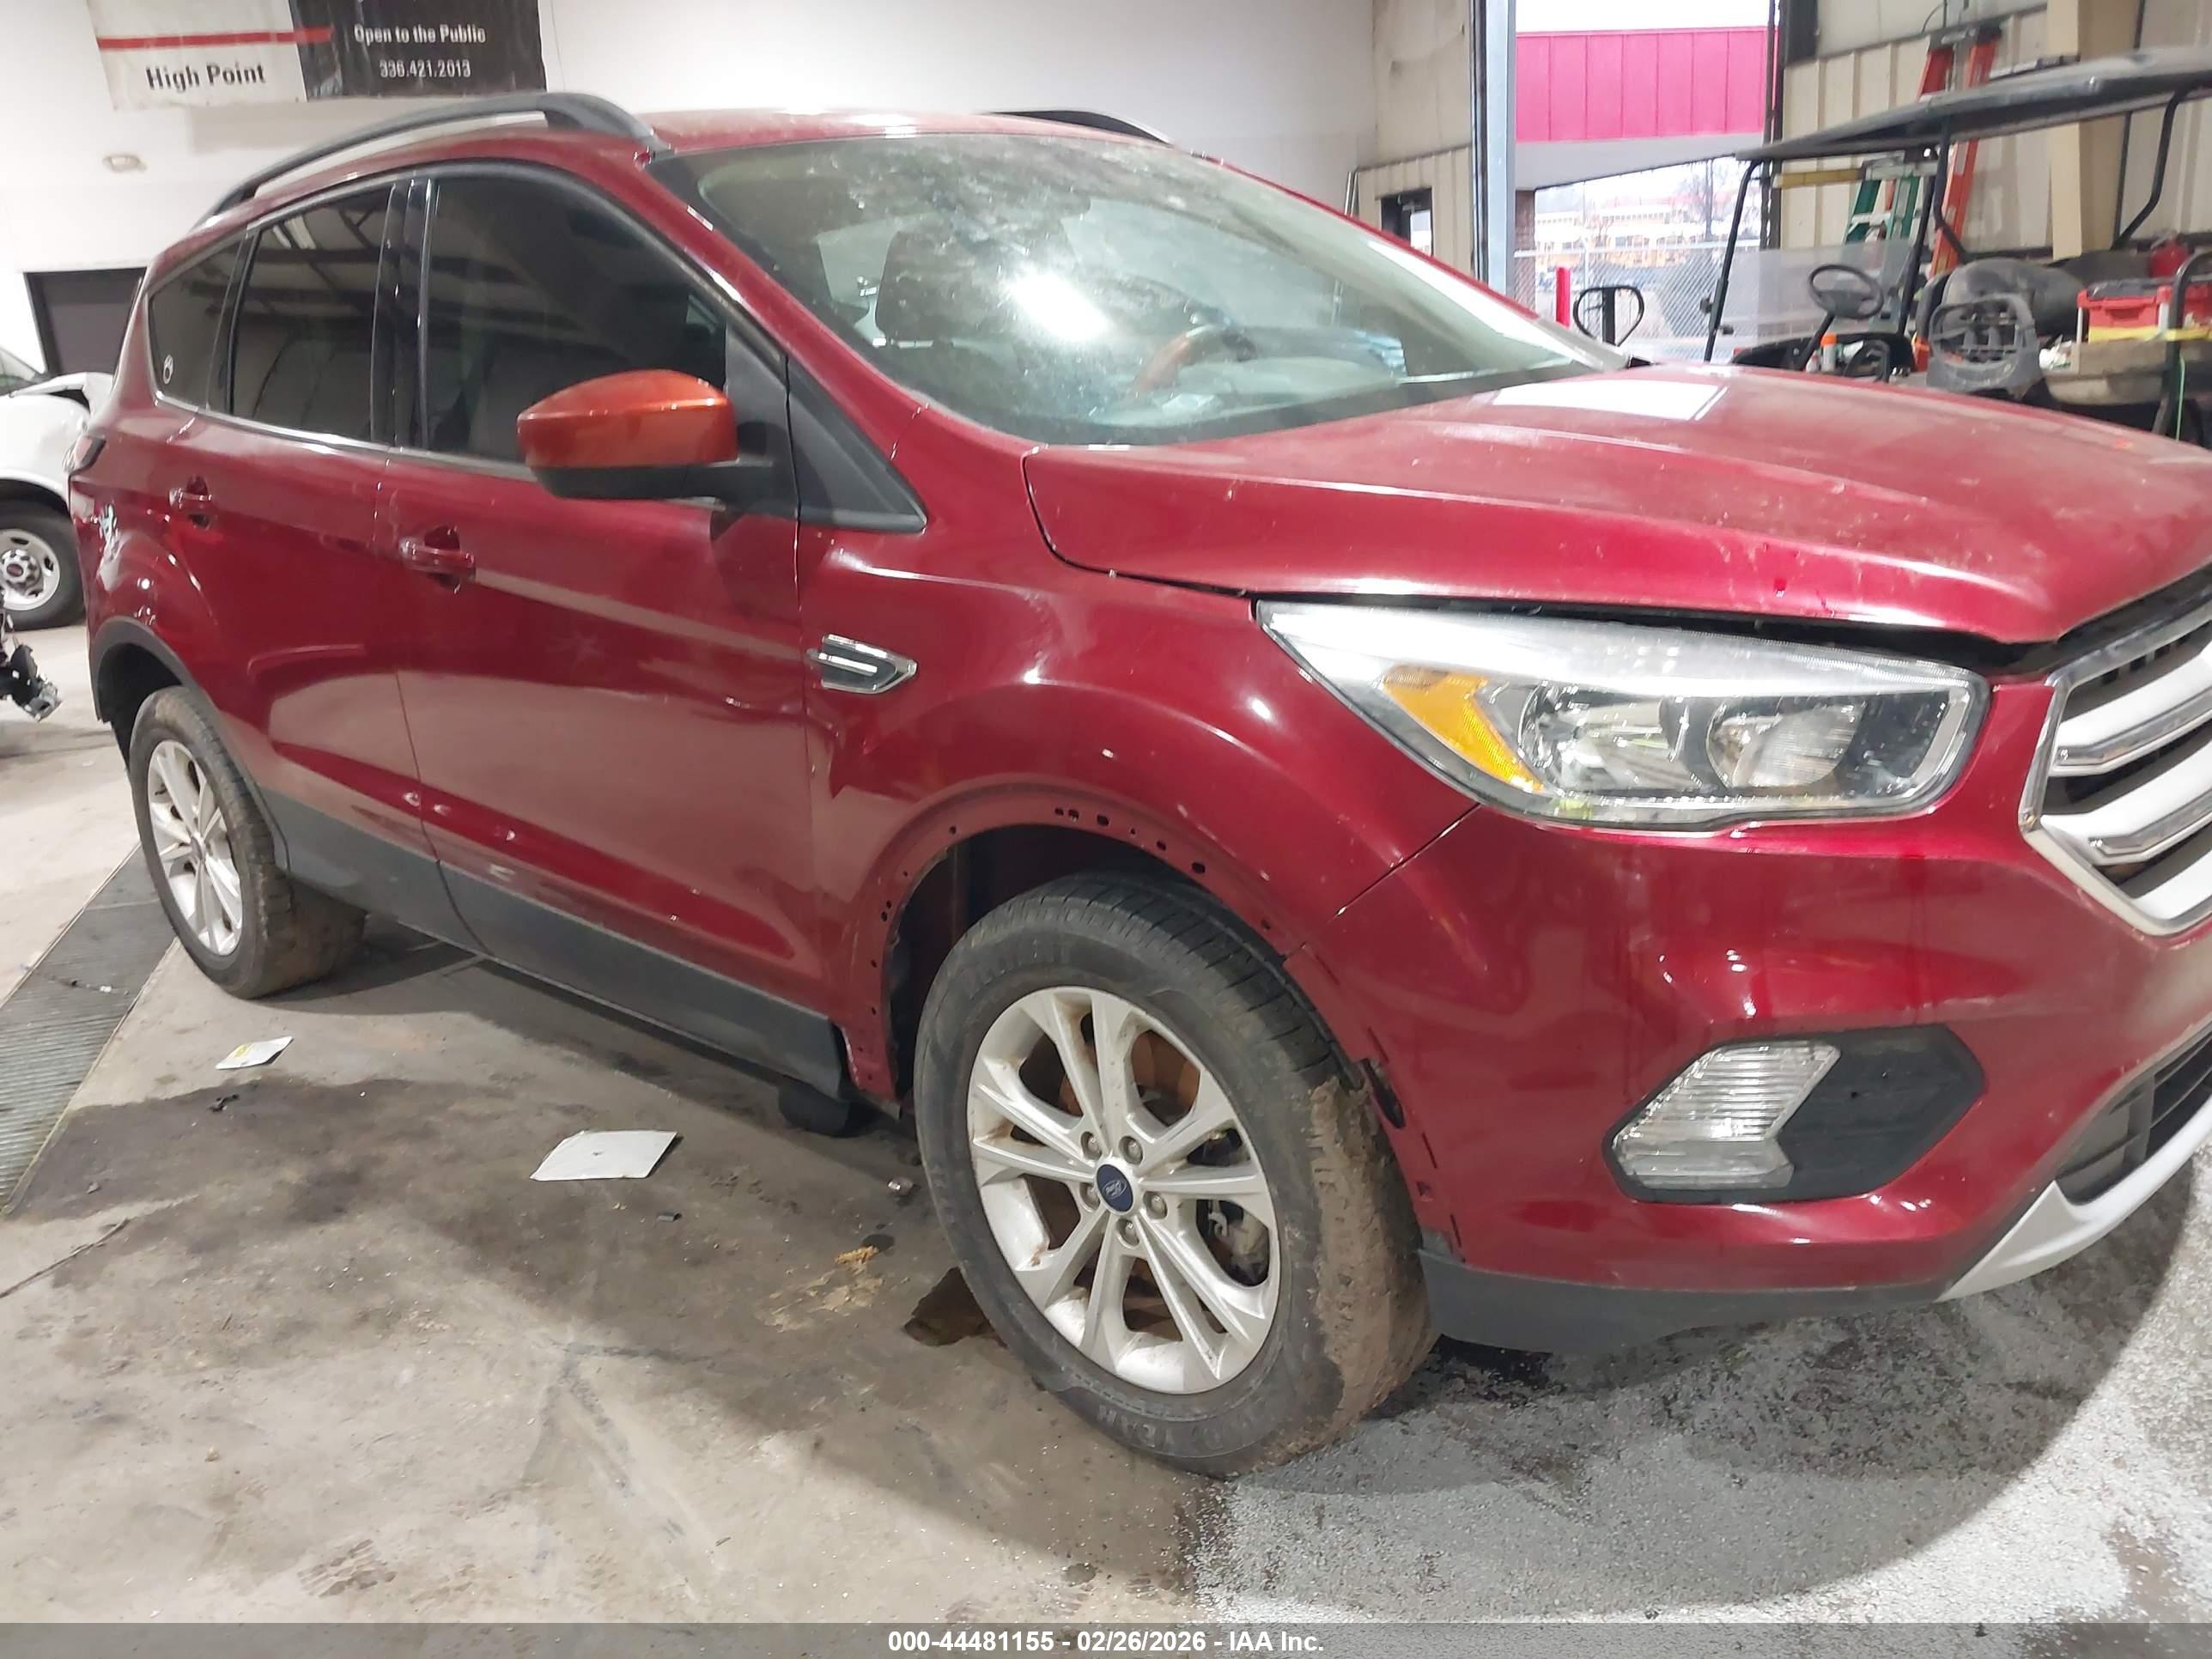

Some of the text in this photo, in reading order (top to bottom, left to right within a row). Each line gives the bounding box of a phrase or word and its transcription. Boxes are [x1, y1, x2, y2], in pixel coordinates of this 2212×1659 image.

[354, 23, 486, 46] Open to the Public
[145, 61, 266, 94] High Point
[380, 59, 471, 78] 336.421.2013
